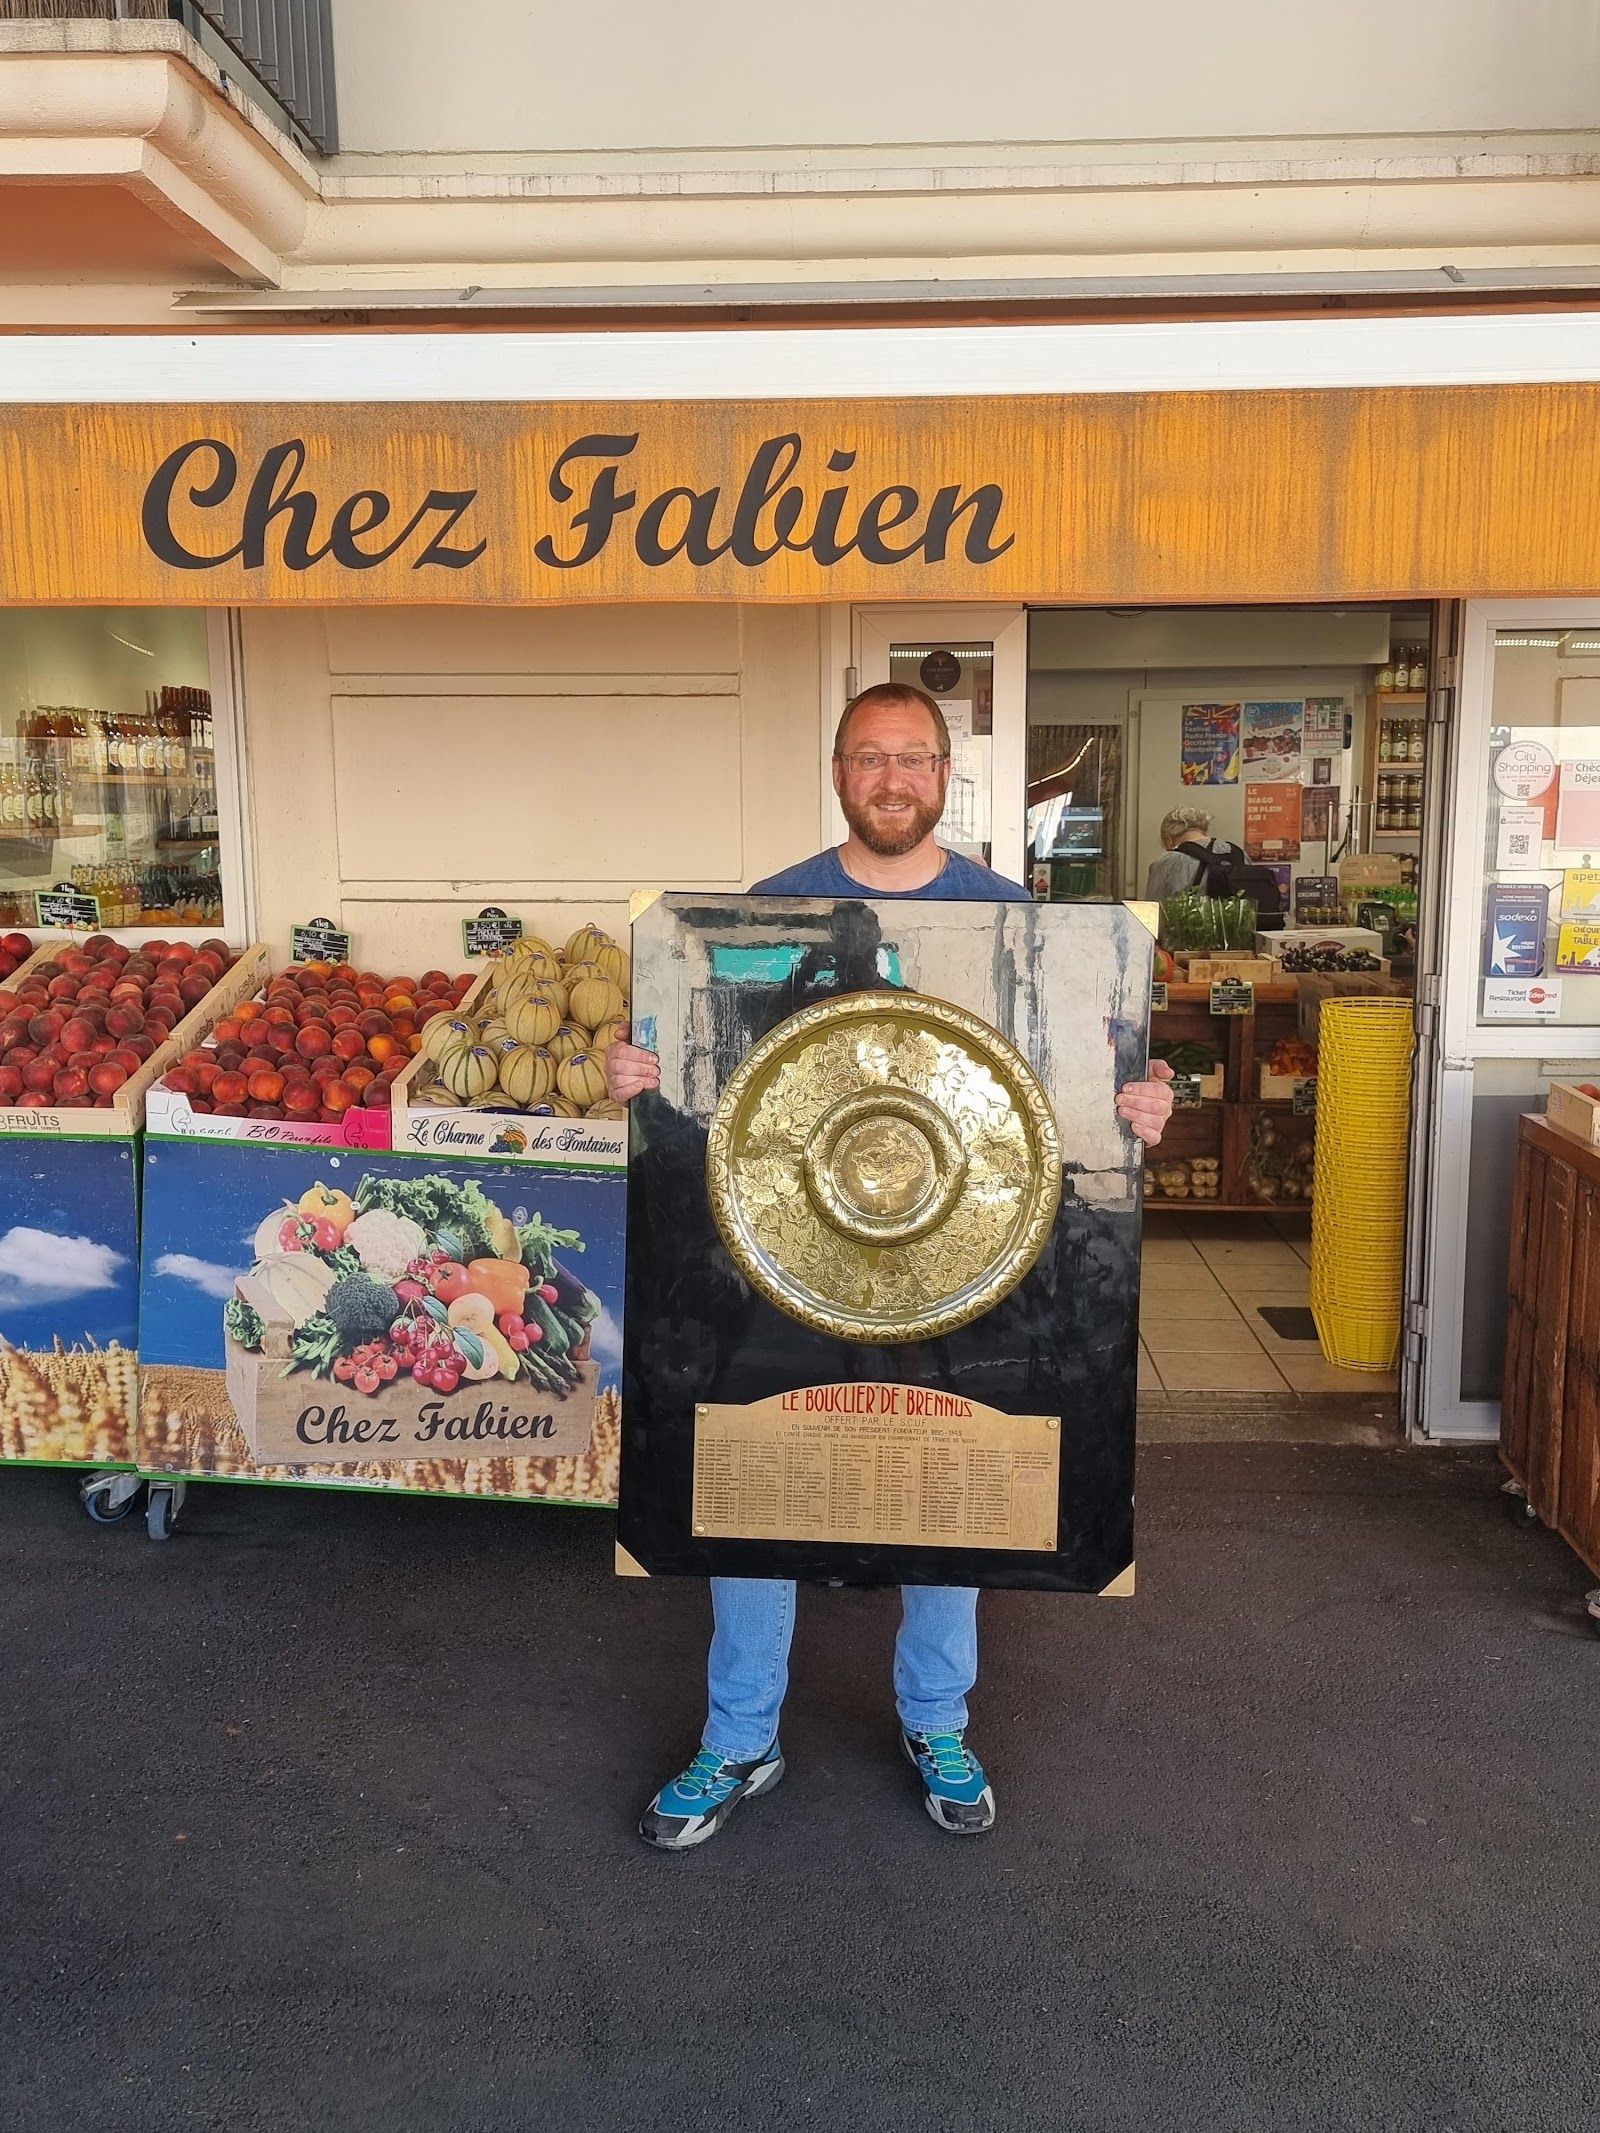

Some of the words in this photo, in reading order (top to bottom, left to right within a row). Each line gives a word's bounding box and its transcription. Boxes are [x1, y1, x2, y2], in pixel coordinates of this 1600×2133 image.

[141, 437, 488, 571] Chez
[534, 432, 1016, 569] Fabien
[1514, 750, 1537, 764] City
[1498, 762, 1551, 775] Shopping
[60, 883, 75, 895] 1kg
[314, 918, 329, 929] 1kg
[1497, 912, 1538, 922] sodexo
[1572, 936, 1600, 946] TABLE
[246, 1125, 280, 1139] BO
[406, 1118, 430, 1147] Le
[433, 1120, 484, 1146] Charme
[531, 1125, 554, 1151] des
[555, 1127, 624, 1154] Fontaines
[782, 1391, 799, 1411] LE
[805, 1385, 876, 1414] BOUCLIER
[880, 1386, 901, 1415] DE
[906, 1389, 973, 1418] BRENNUS
[295, 1404, 400, 1446] Chez
[413, 1400, 559, 1442] Fabien
[824, 1415, 857, 1425] OFFERT
[862, 1416, 880, 1426] PAR
[884, 1417, 895, 1426] LE
[803, 1424, 831, 1432] SOUVENIR
